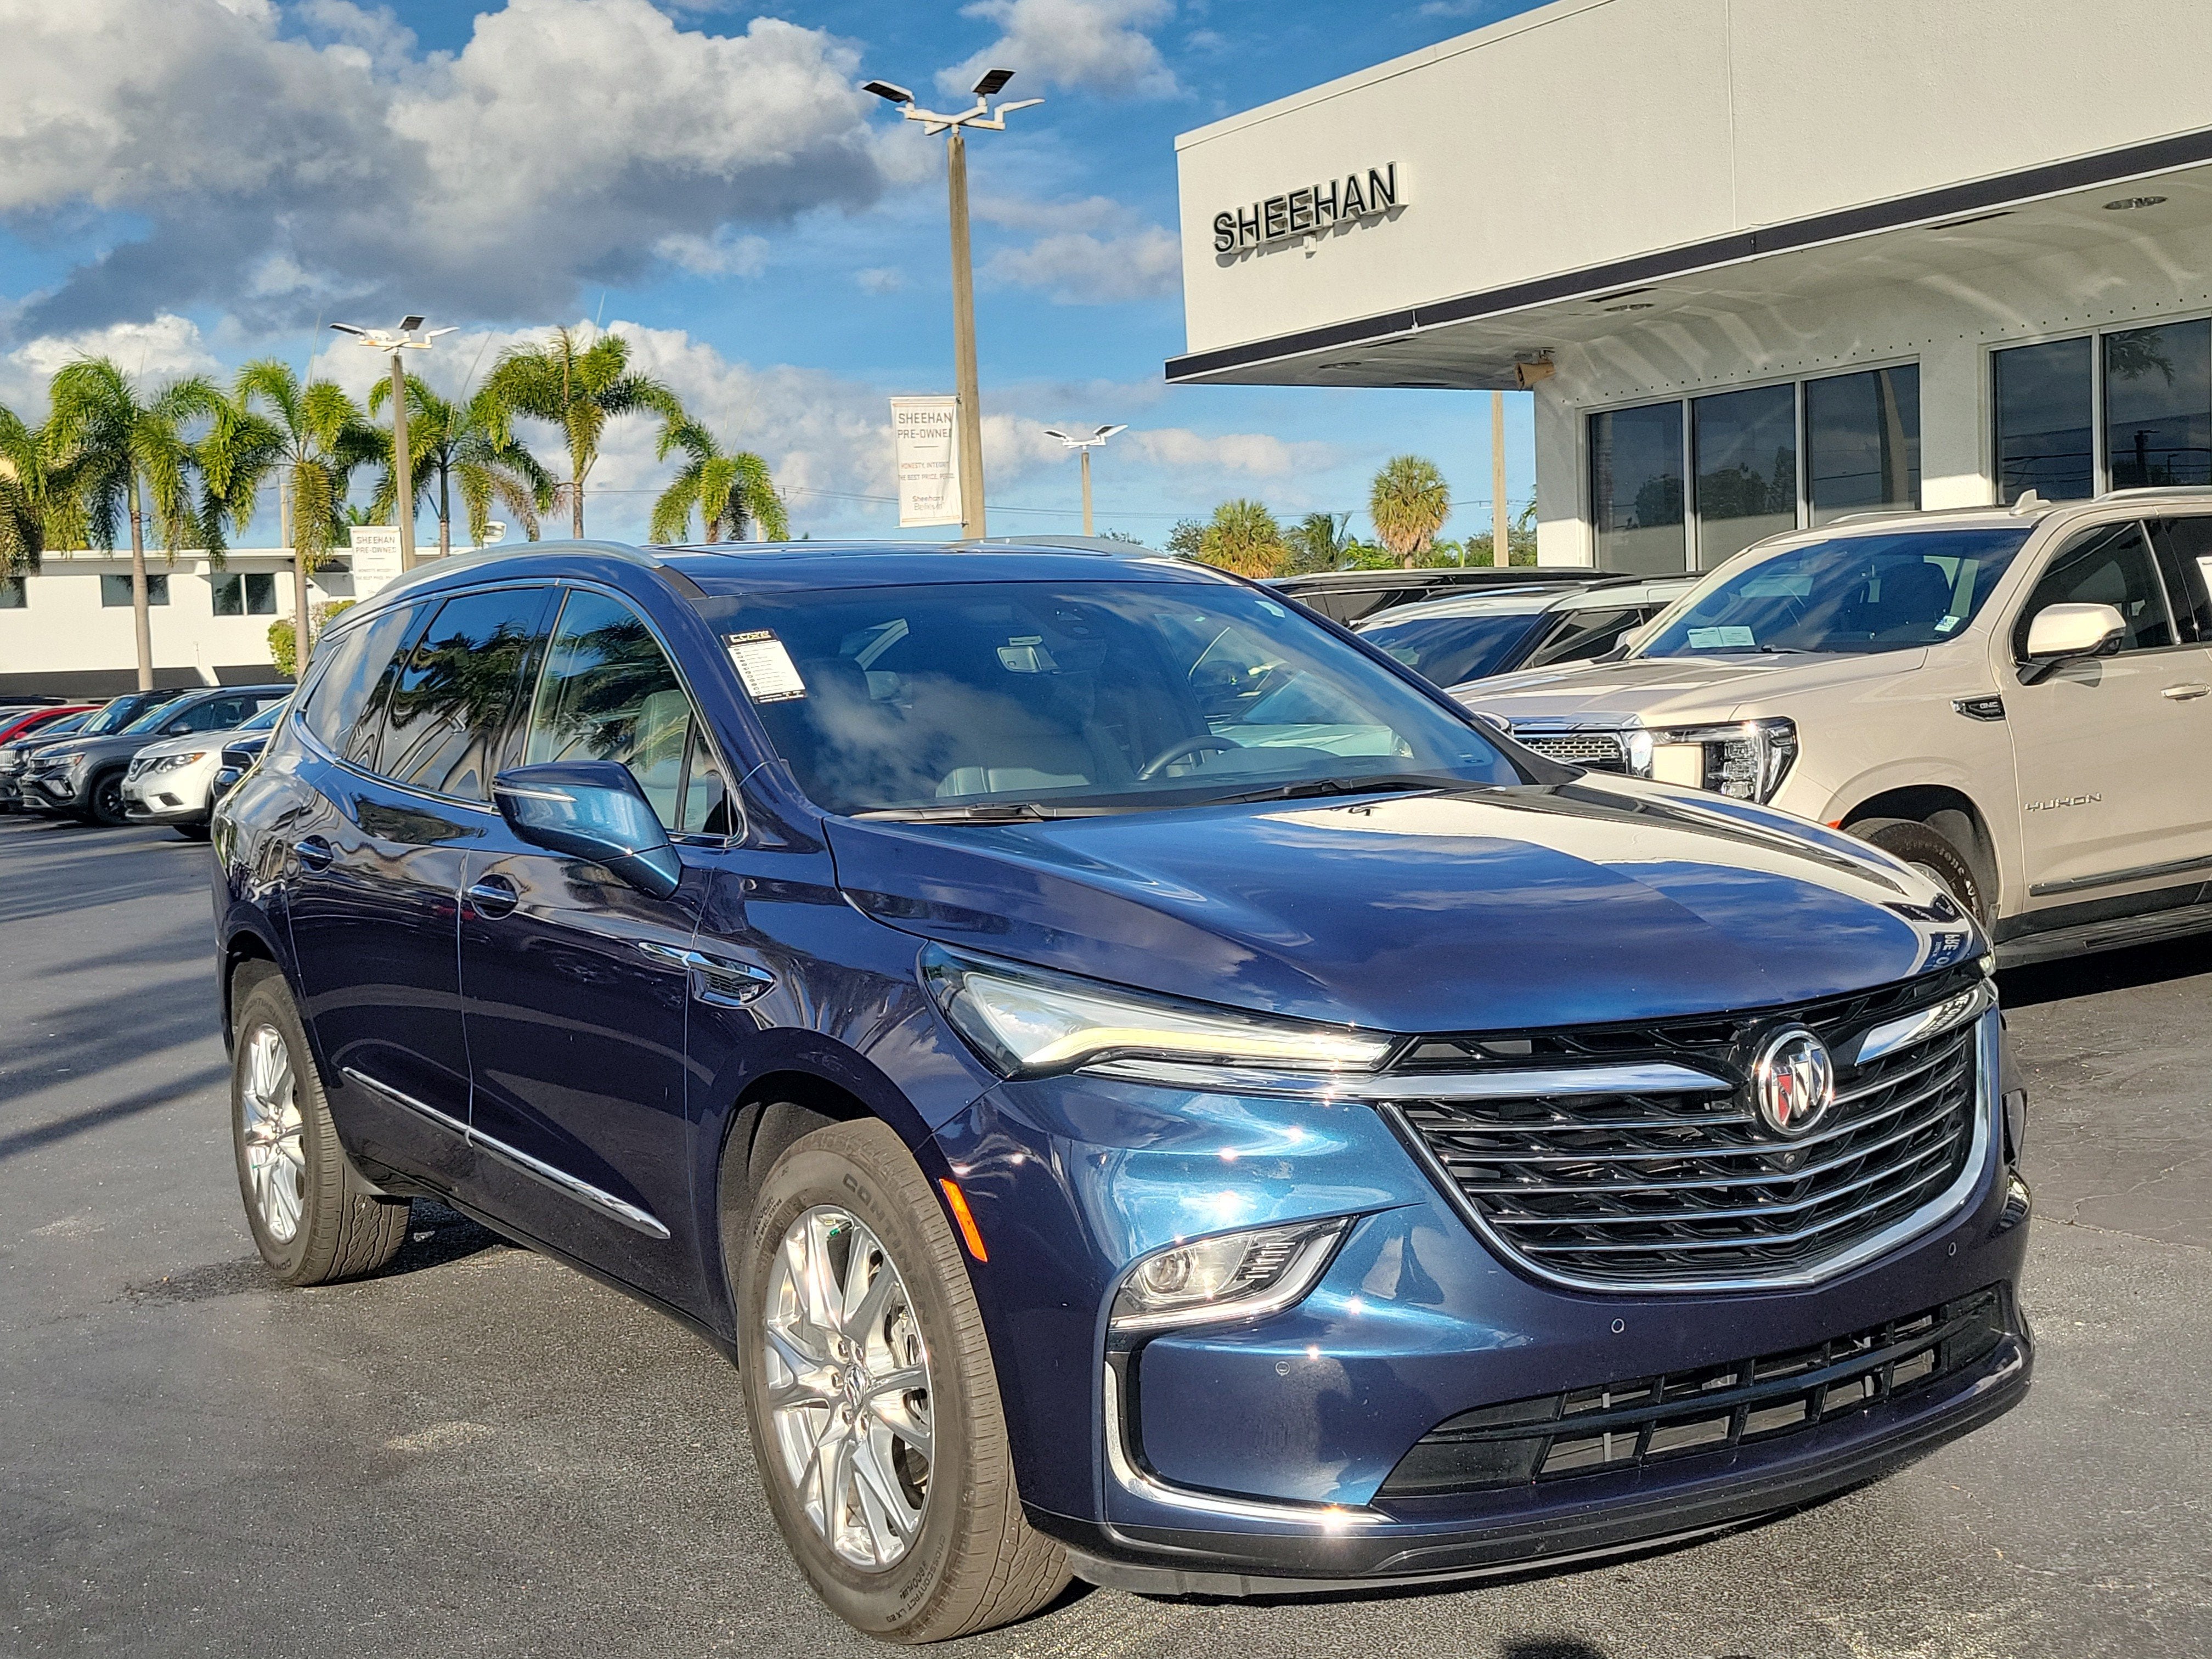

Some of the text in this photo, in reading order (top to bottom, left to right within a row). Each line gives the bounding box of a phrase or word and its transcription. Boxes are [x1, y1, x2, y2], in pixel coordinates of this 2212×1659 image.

[1213, 161, 1398, 253] SHEEHAN
[898, 413, 952, 424] SHEEHAN
[2024, 793, 2102, 812] YUKON
